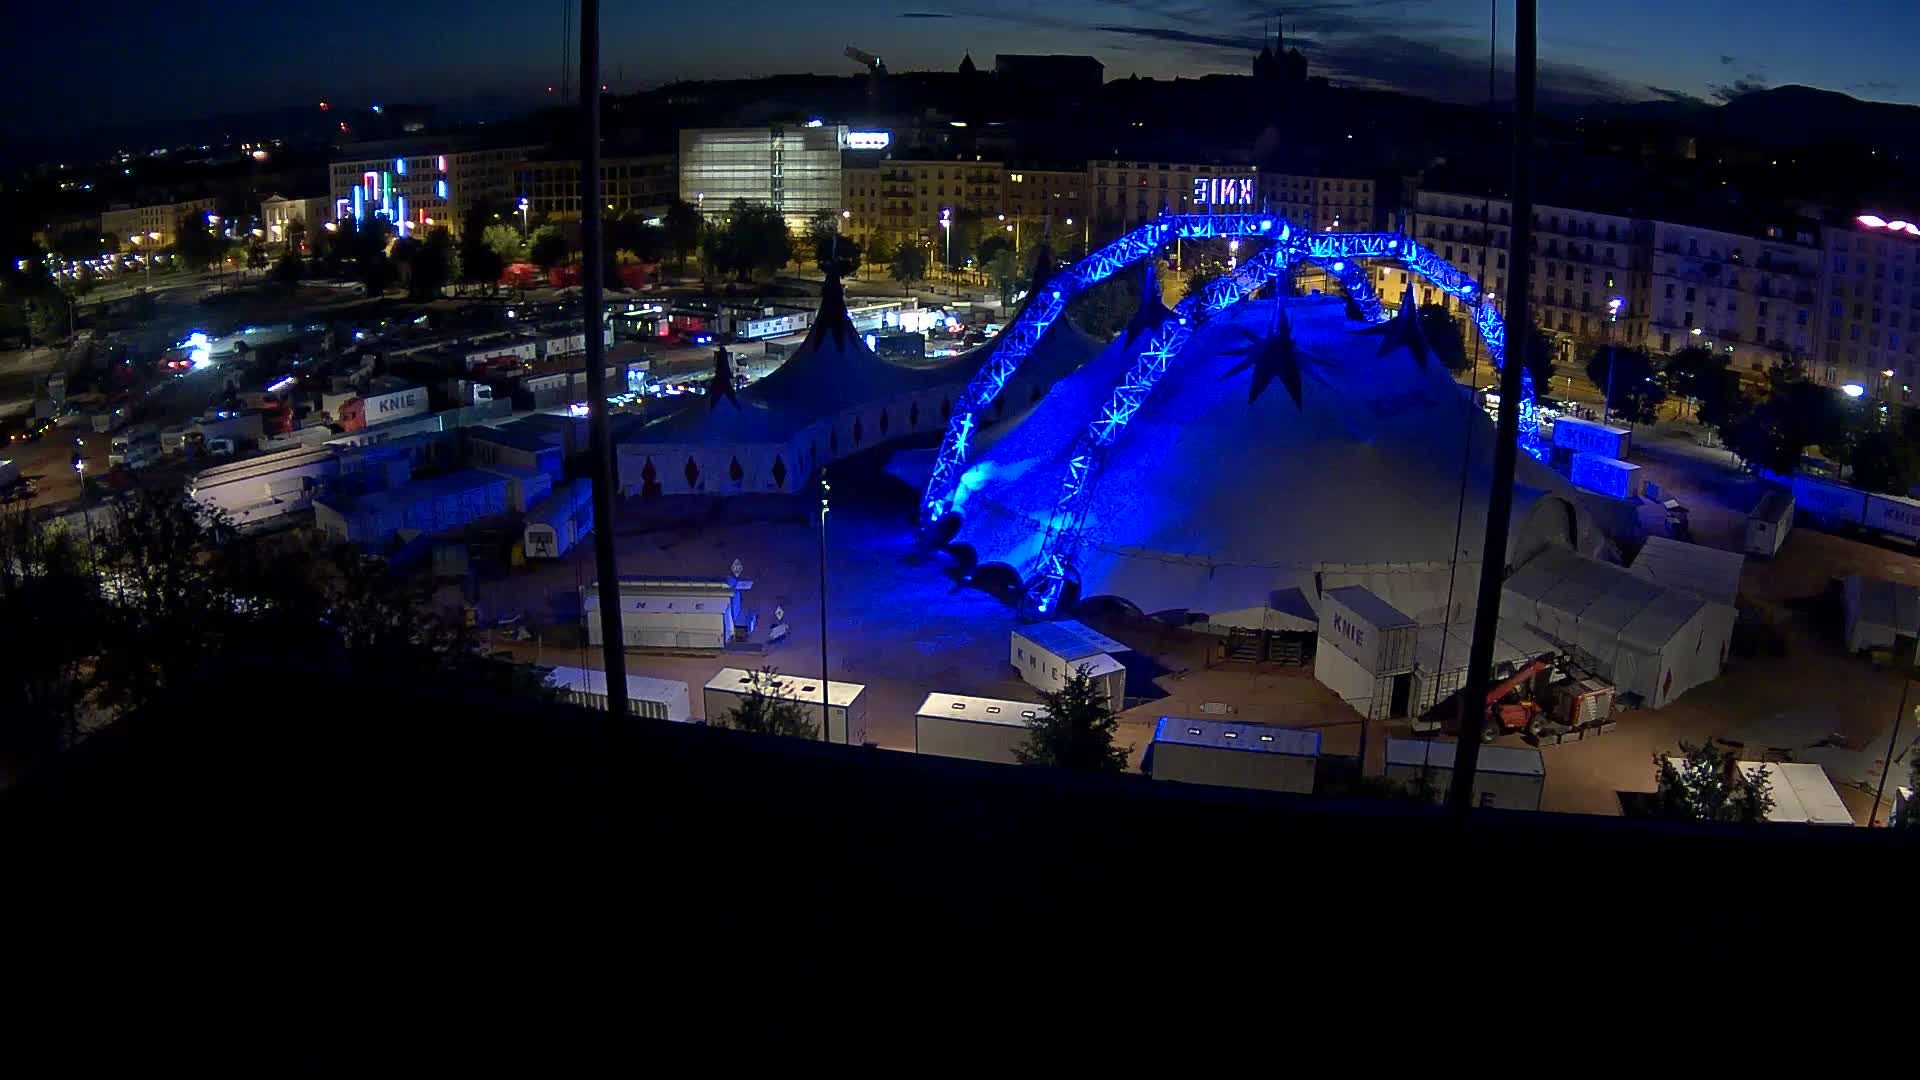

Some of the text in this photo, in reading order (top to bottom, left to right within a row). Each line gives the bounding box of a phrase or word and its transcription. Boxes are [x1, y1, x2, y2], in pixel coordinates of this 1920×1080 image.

[380, 394, 415, 412] KNIE
[1333, 610, 1364, 648] KNIE
[1018, 647, 1058, 681] KNIE
